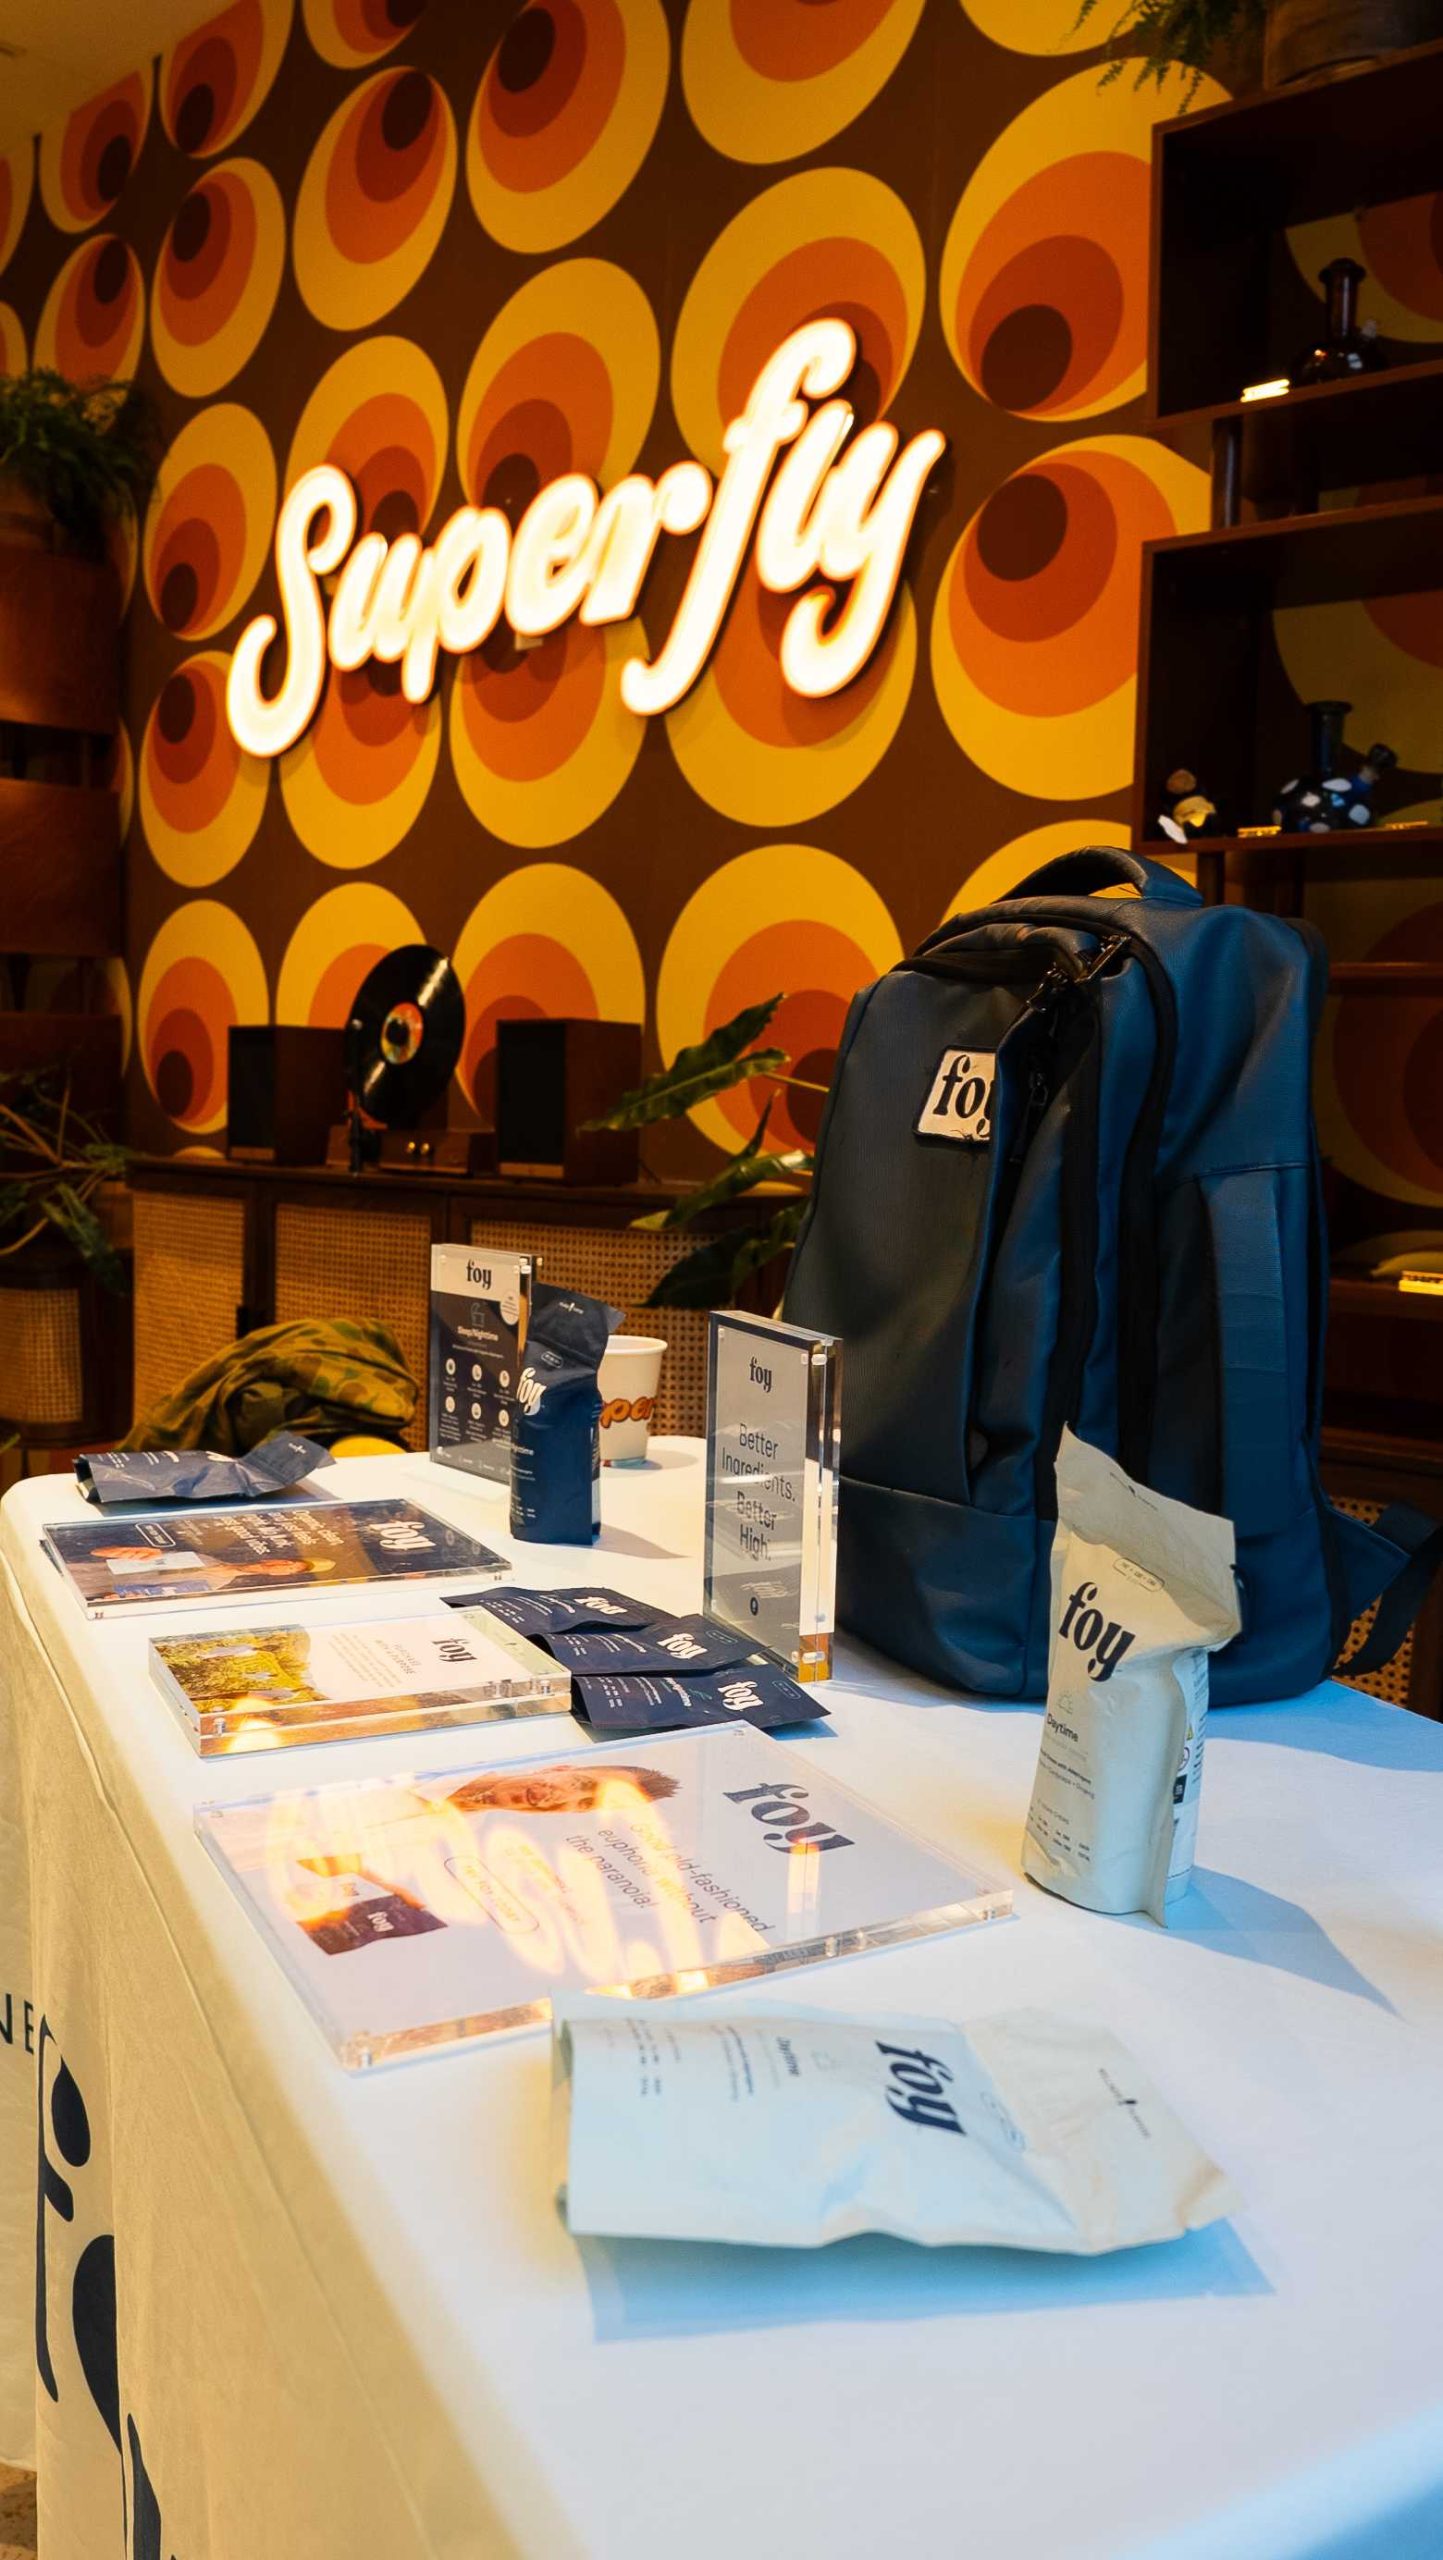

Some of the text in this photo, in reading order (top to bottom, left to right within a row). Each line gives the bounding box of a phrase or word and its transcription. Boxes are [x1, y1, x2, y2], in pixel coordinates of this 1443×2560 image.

[227, 316, 946, 757] Superfly
[466, 1259, 492, 1290] foy
[516, 1367, 547, 1416] foy
[750, 1356, 773, 1393] foy
[739, 1423, 779, 1460] Better
[737, 1490, 776, 1530] Better
[368, 1521, 437, 1551] foy
[432, 1638, 478, 1663] foy
[657, 1633, 709, 1660] foy
[1059, 1582, 1136, 1682] foy
[718, 1681, 764, 1711] foy
[1046, 1713, 1079, 1743] Daytime
[722, 1783, 855, 1854] foy
[565, 1834, 594, 1855] the
[667, 1846, 776, 1932] old-fashioned
[367, 1910, 396, 1932] foy
[876, 2040, 967, 2136] foy
